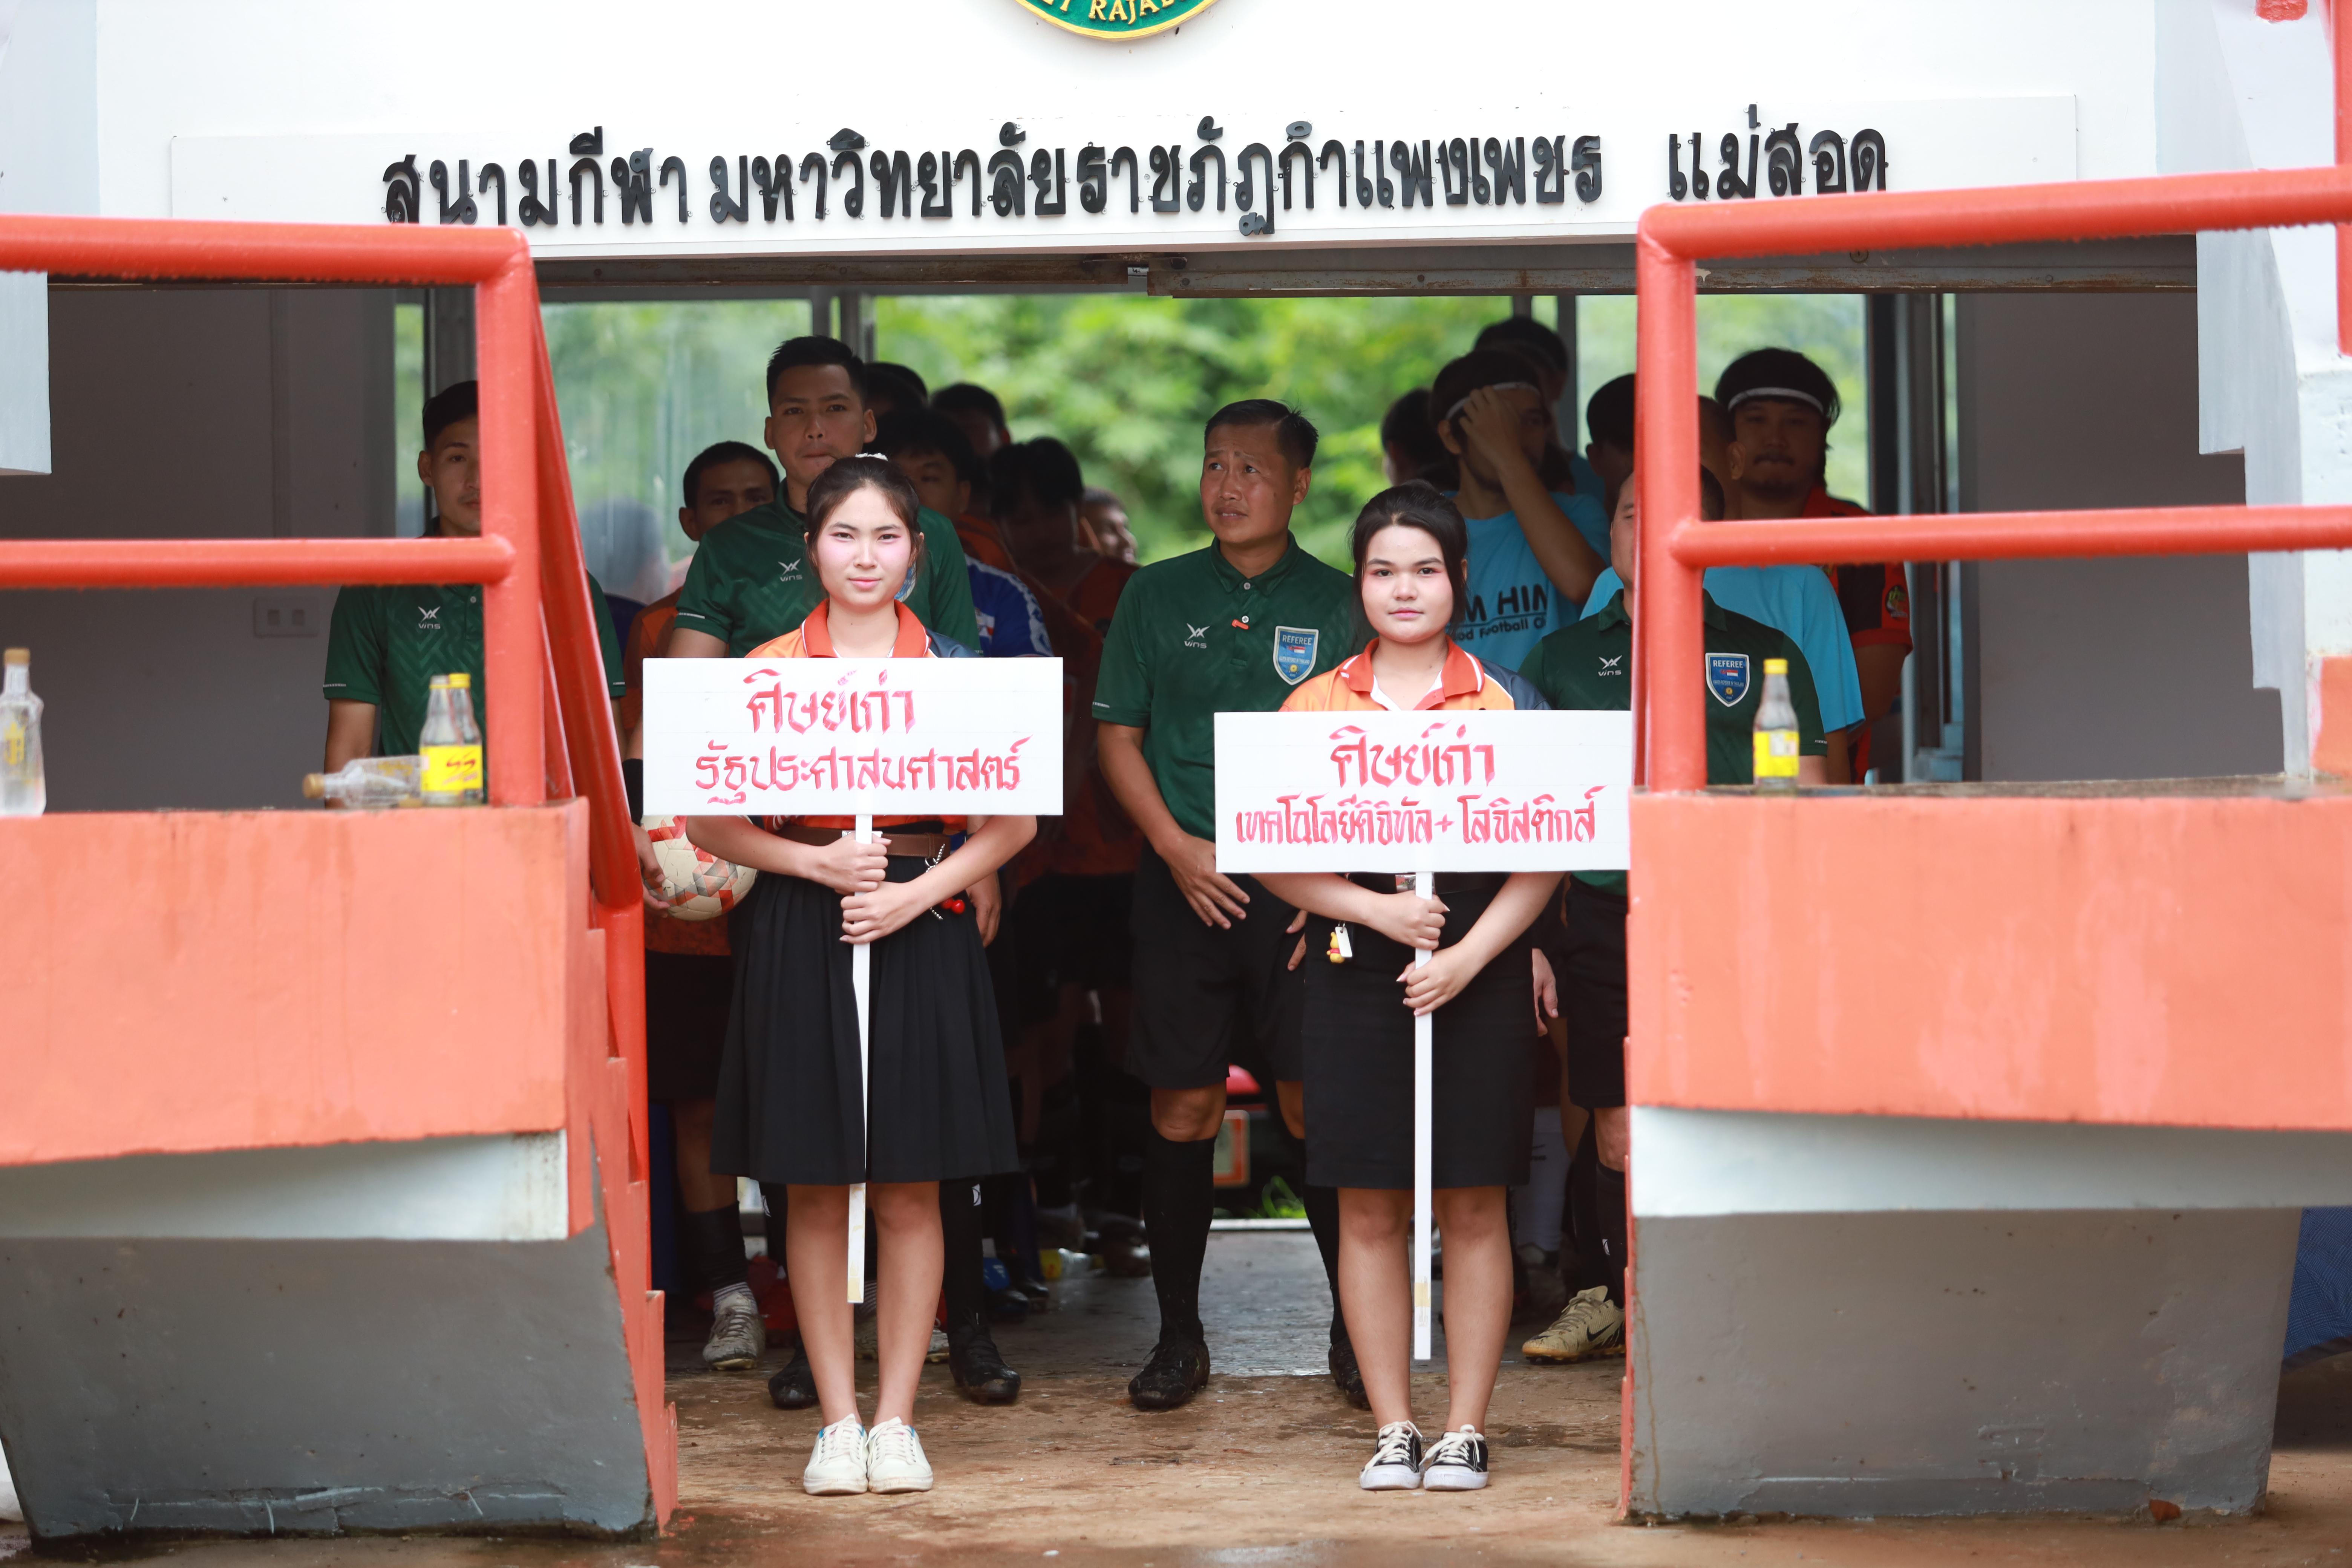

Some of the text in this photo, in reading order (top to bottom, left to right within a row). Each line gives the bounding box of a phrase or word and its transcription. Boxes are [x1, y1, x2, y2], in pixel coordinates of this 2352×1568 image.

[1669, 104, 1886, 199] แม่สอด
[1282, 634, 1312, 646] REFEREE
[1713, 660, 1744, 668] REFEREE
[743, 668, 916, 734] ศิษย์เก่า
[695, 734, 1034, 805] รัฐประศาสนศาสตร์
[1329, 719, 1495, 787] ศิษย์เก่า
